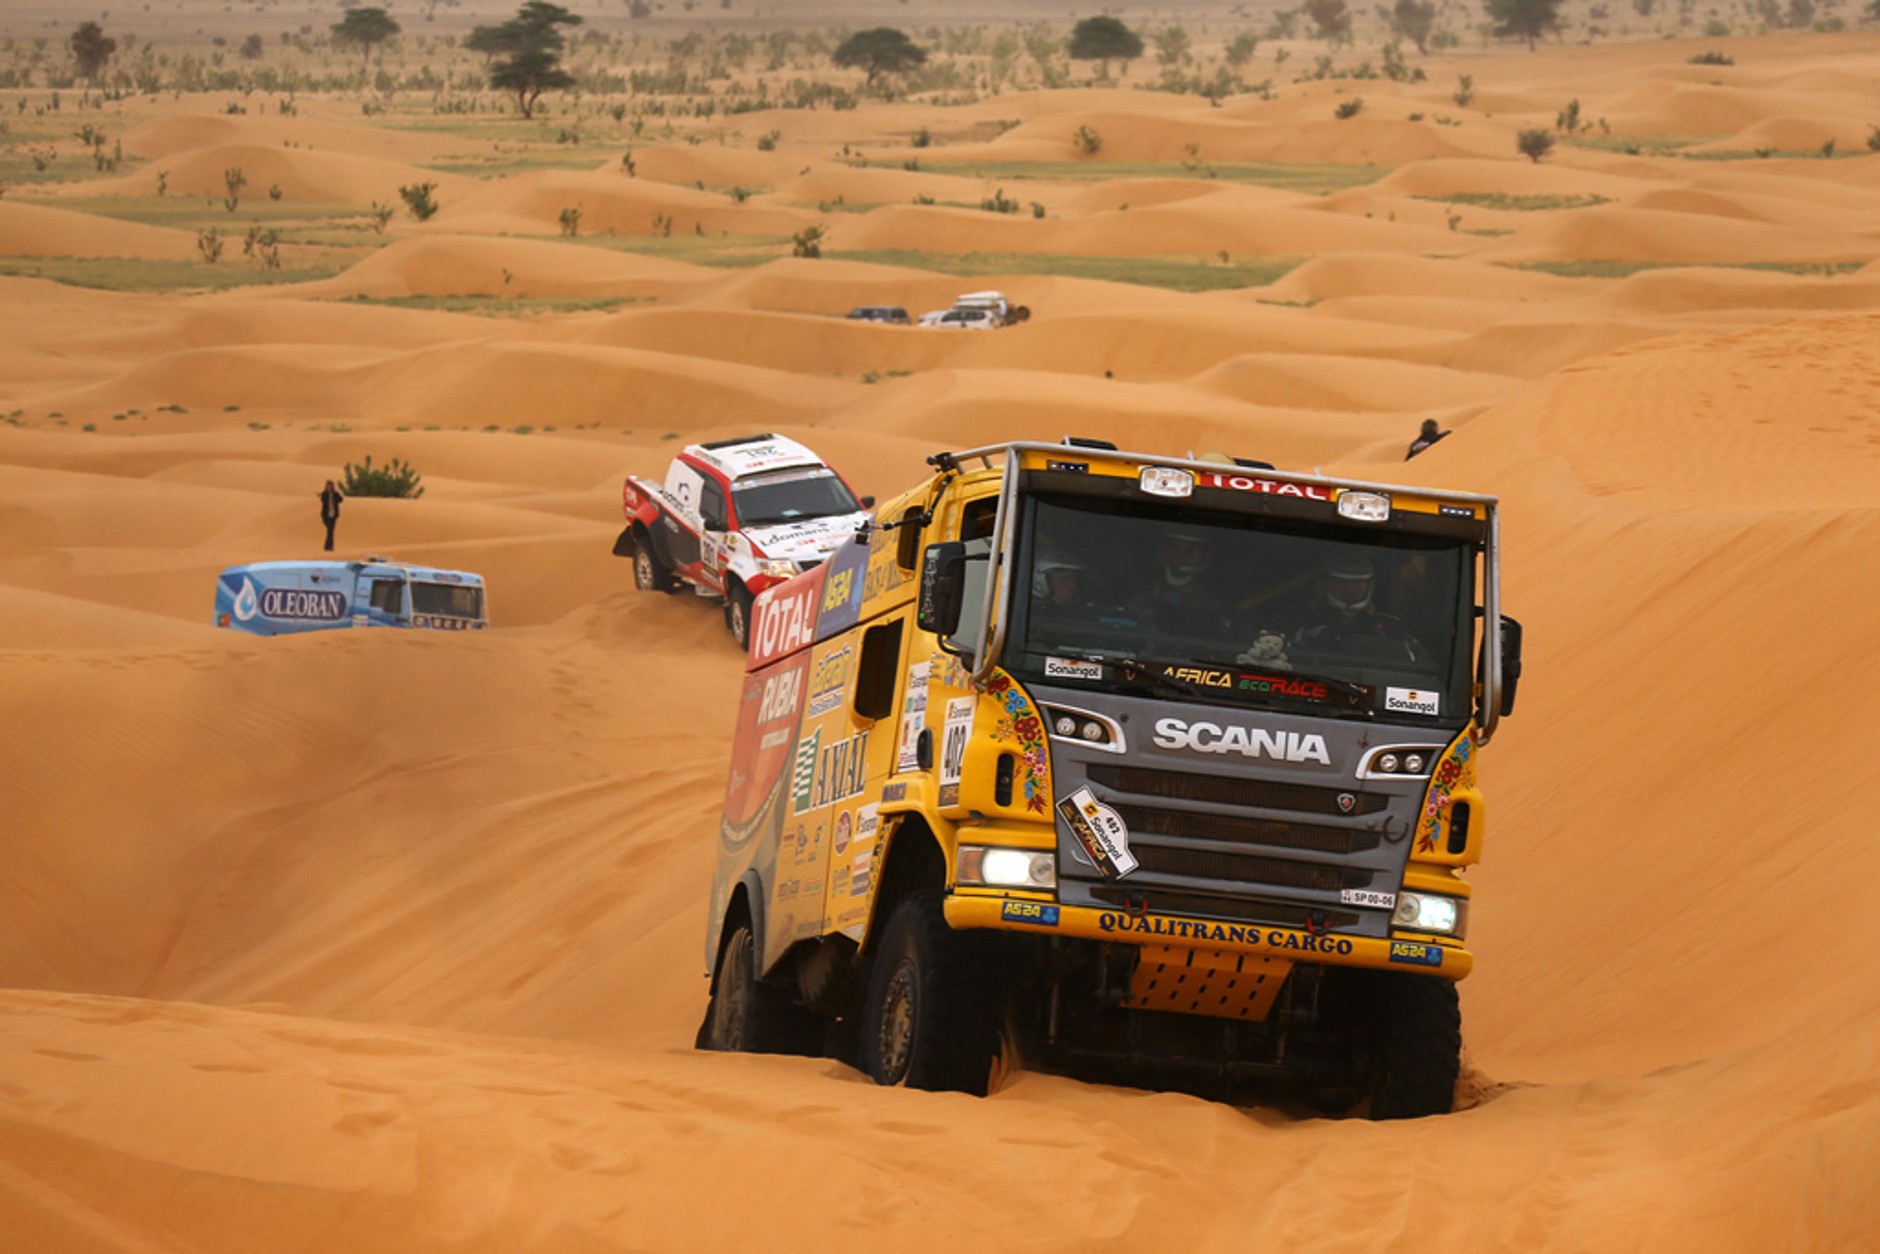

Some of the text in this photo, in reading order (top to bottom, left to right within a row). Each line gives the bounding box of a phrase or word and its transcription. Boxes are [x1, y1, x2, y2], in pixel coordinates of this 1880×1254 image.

[1205, 471, 1327, 501] TOTAL
[264, 591, 341, 617] OLEOBAN
[754, 588, 813, 660] TOTAL
[1048, 663, 1100, 677] Sonangol
[1164, 666, 1232, 688] AFRICA
[1388, 697, 1436, 713] Sonangol
[1153, 717, 1331, 766] SCANIA
[1090, 816, 1123, 861] Sonangol
[1099, 912, 1353, 956] QUALITRANS CARGO
